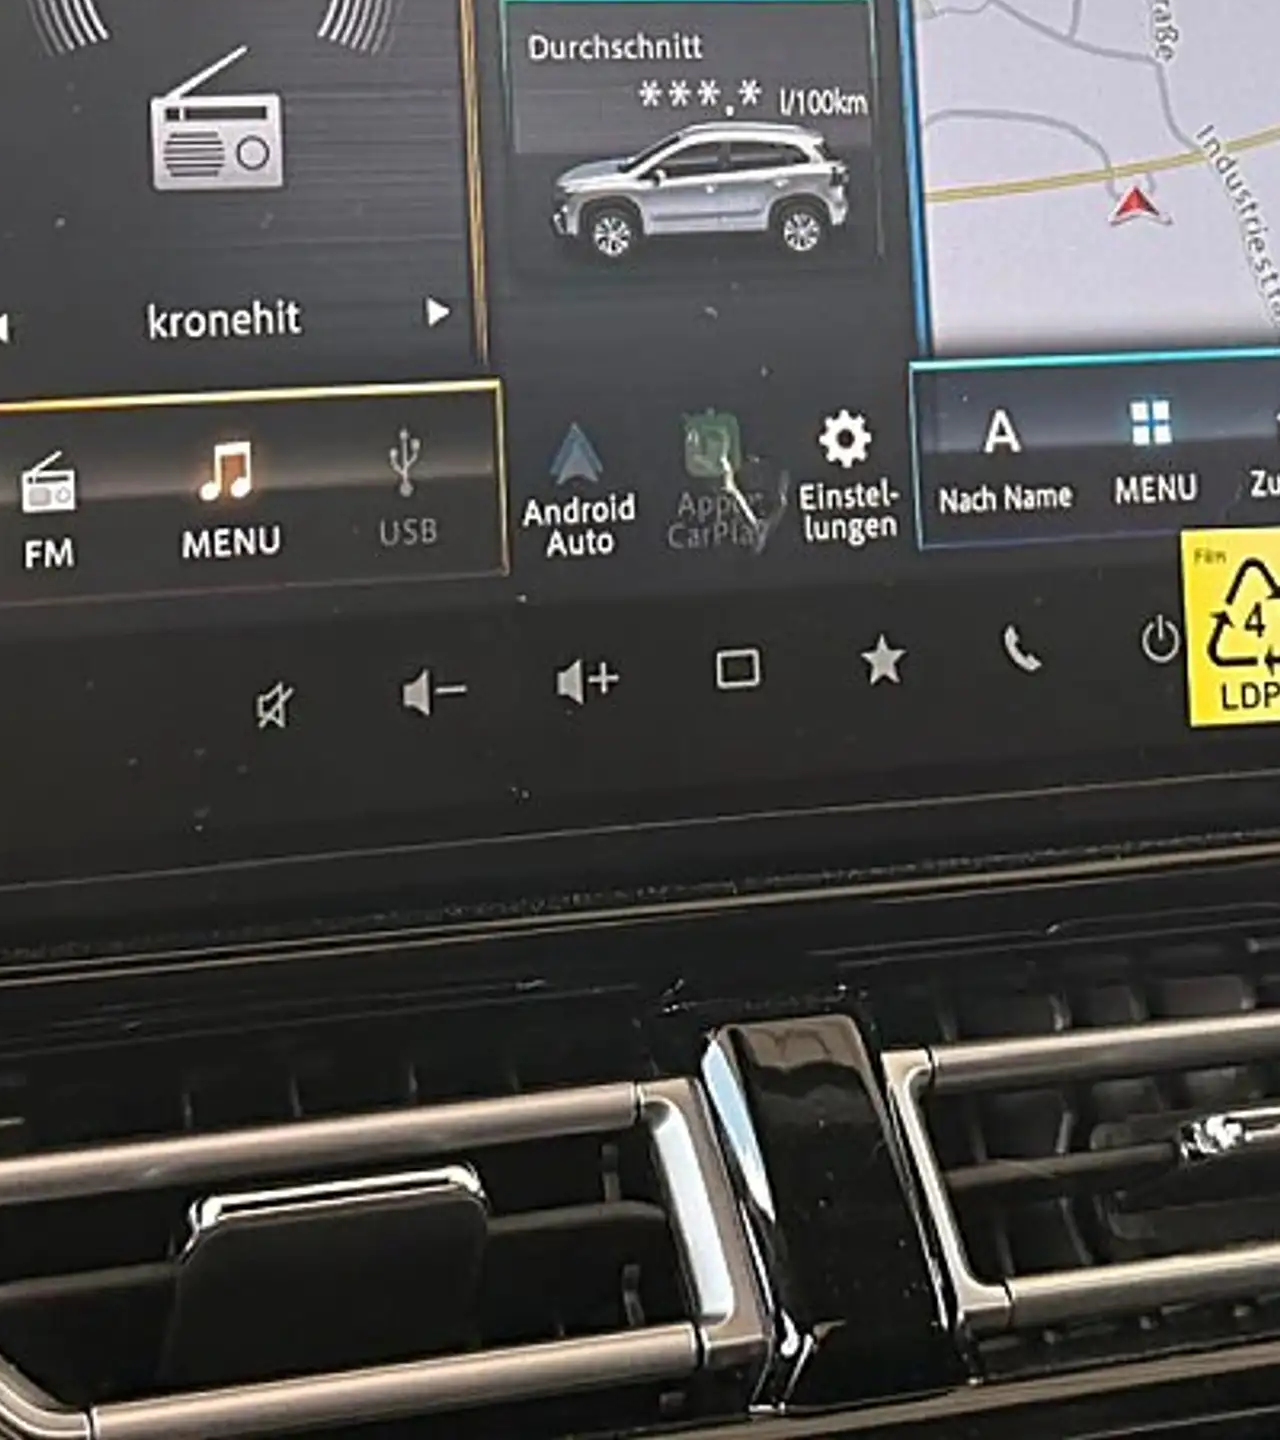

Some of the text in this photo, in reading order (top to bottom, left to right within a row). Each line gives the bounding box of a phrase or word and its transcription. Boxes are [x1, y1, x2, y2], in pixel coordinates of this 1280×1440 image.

[528, 34, 704, 61] Durchschnitt
[146, 299, 303, 340] kronehit
[799, 477, 900, 511] Einstel-
[938, 483, 1074, 515] Nach Name
[1115, 473, 1198, 504] MENU
[521, 492, 637, 527] Android
[181, 526, 282, 559] MENU
[379, 518, 438, 547] USB
[545, 529, 615, 558] Auto
[804, 513, 898, 547] lungen
[24, 538, 76, 569] FM
[1244, 601, 1267, 638] 4
